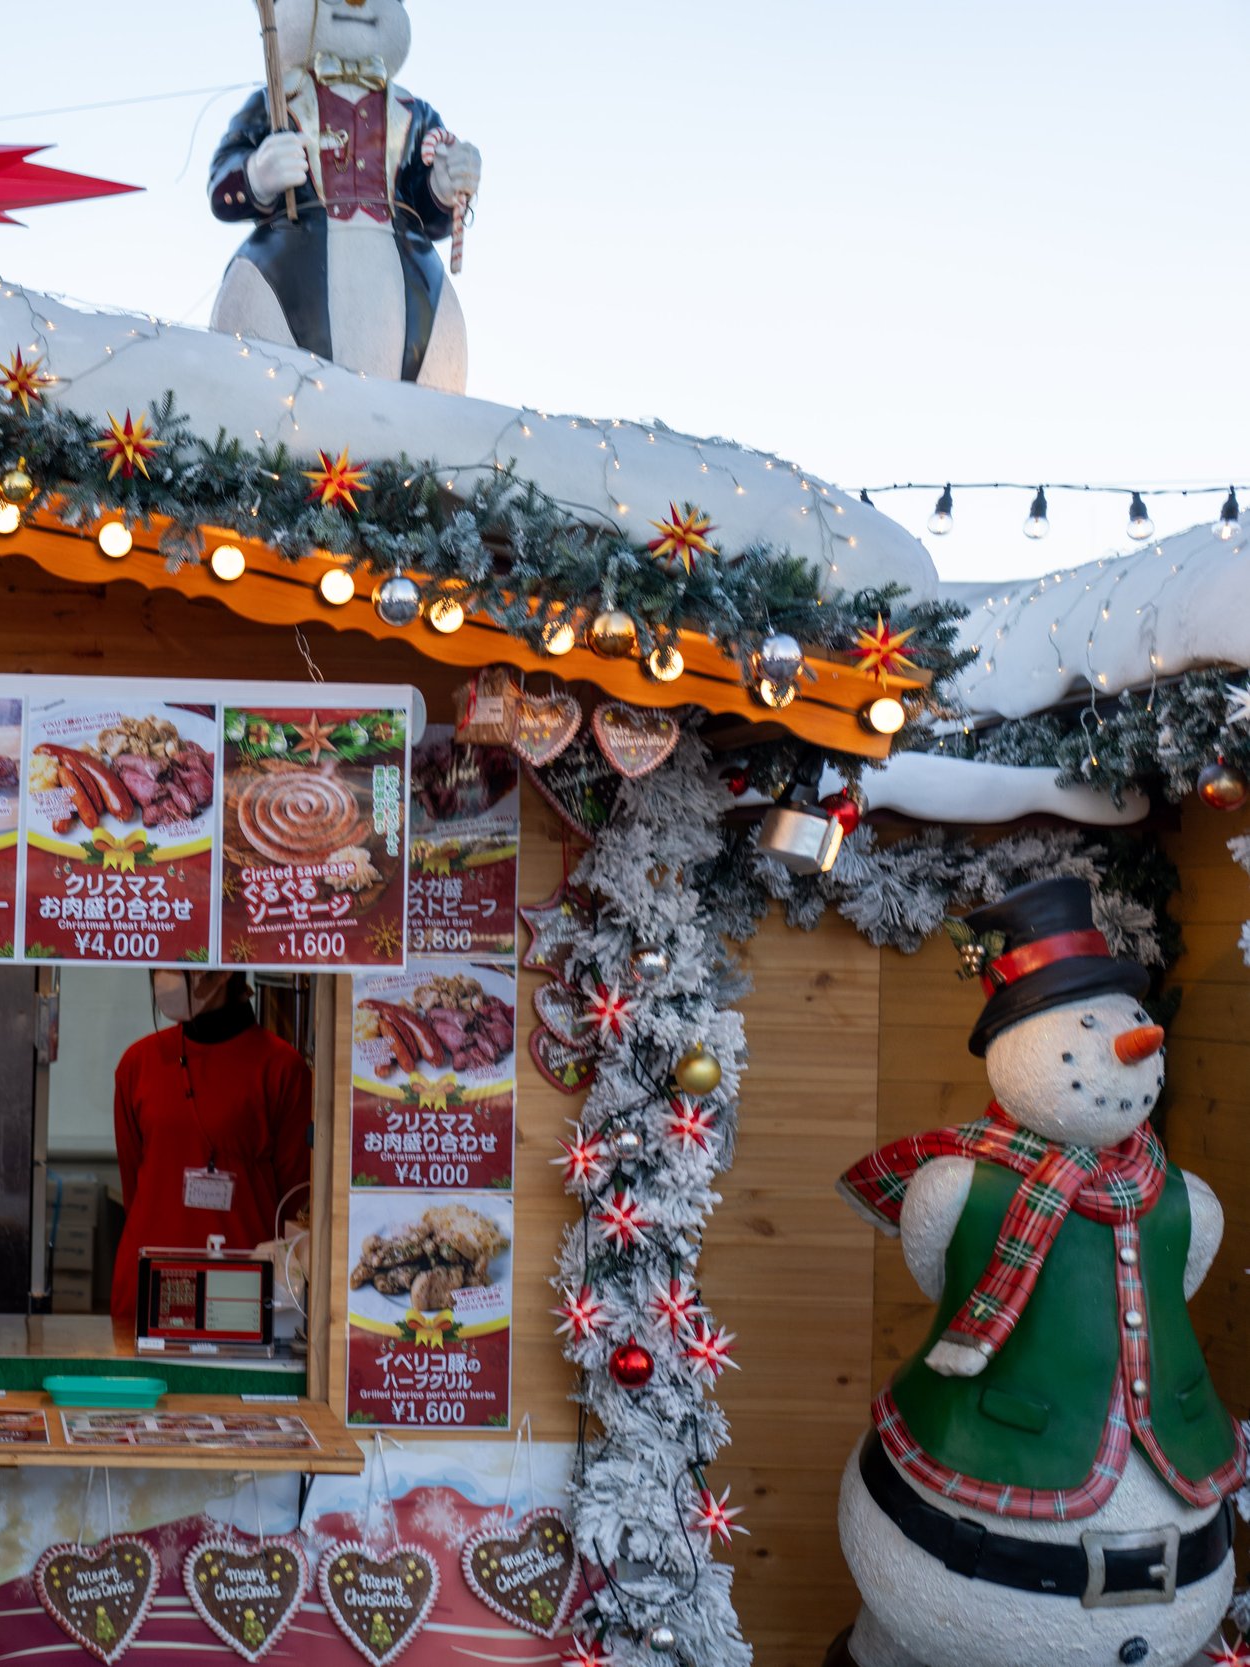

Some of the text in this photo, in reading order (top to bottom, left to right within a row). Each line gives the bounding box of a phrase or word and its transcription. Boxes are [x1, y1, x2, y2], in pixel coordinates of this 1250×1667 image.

[241, 861, 356, 882] Circled sausage
[64, 873, 168, 898] クリスマス
[243, 878, 318, 904] ぐるぐる
[39, 895, 194, 921] お肉盛り合わせ
[247, 894, 352, 925] ソーセージ
[408, 896, 498, 918] ストビーフ
[58, 918, 176, 932] Christmas Meat Platter
[74, 931, 160, 960] ¥4,000
[279, 931, 346, 960] ¥1,600
[407, 928, 472, 951] 3,800
[386, 1112, 476, 1133] クリスマス
[364, 1131, 498, 1154] お肉盛り合わせ
[380, 1151, 483, 1164] Christmas Meat Platter
[395, 1162, 469, 1188] ¥4,000
[375, 1352, 481, 1374] イベリコ豚の
[383, 1373, 472, 1391] ハーブグリル
[360, 1389, 391, 1400] Grilled
[426, 1390, 447, 1401] pork
[448, 1390, 468, 1400] with
[469, 1390, 496, 1400] herbs
[391, 1401, 466, 1425] ¥1,600
[500, 1547, 546, 1572] Merry
[76, 1565, 122, 1585] Merry
[225, 1567, 268, 1586] Merry
[358, 1572, 405, 1595] Merry
[495, 1551, 565, 1593] Christmas
[66, 1578, 134, 1604] Christmas
[214, 1582, 282, 1602] Christmas
[343, 1588, 414, 1610] Christmas
